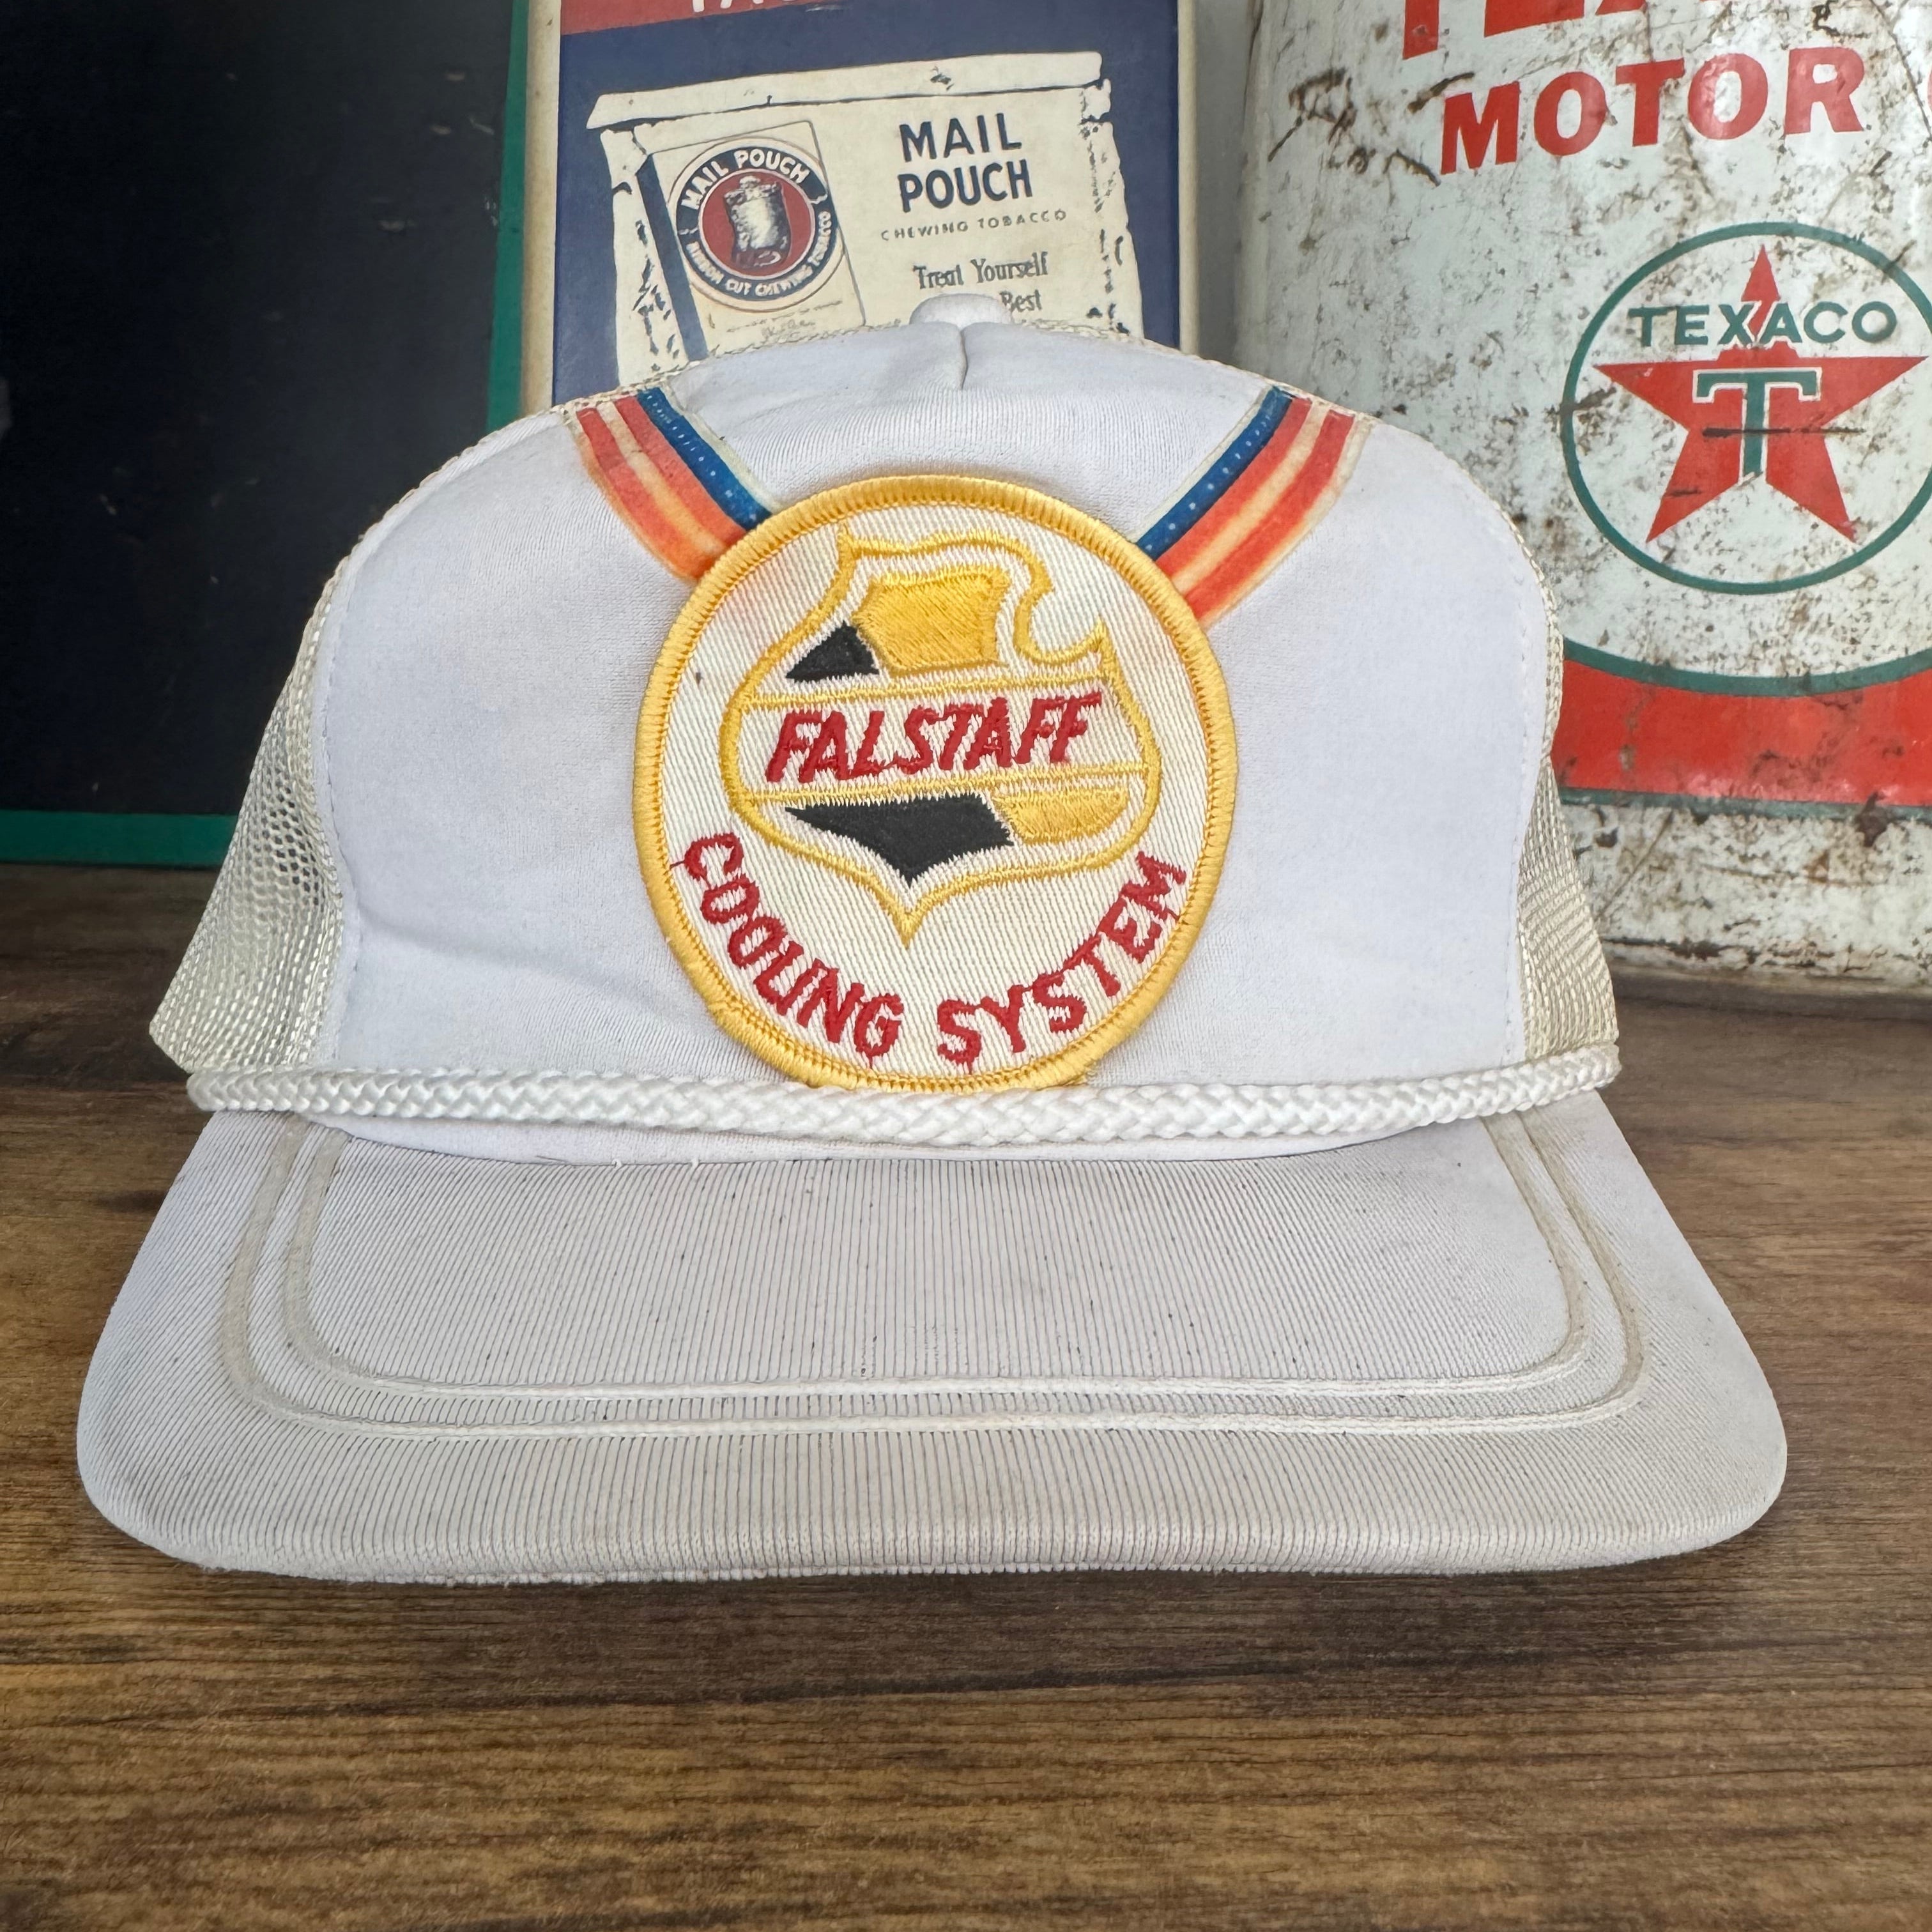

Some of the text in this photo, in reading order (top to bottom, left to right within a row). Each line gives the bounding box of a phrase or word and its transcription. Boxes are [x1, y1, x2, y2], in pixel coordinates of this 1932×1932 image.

[900, 112, 1022, 162] MAIL
[1440, 46, 1866, 174] MOTOR
[681, 148, 810, 210] MAIL POUCH
[898, 158, 1032, 213] POUCH
[881, 208, 1066, 241] CHEWING TOBACCO
[912, 251, 1048, 289] Treat Yourself
[999, 289, 1043, 312] Best
[1627, 300, 1898, 348] TEXACO
[1694, 368, 1821, 479] T
[766, 691, 1103, 784] FALSTAFF
[678, 832, 1188, 1066] COOLING SYSTEM
